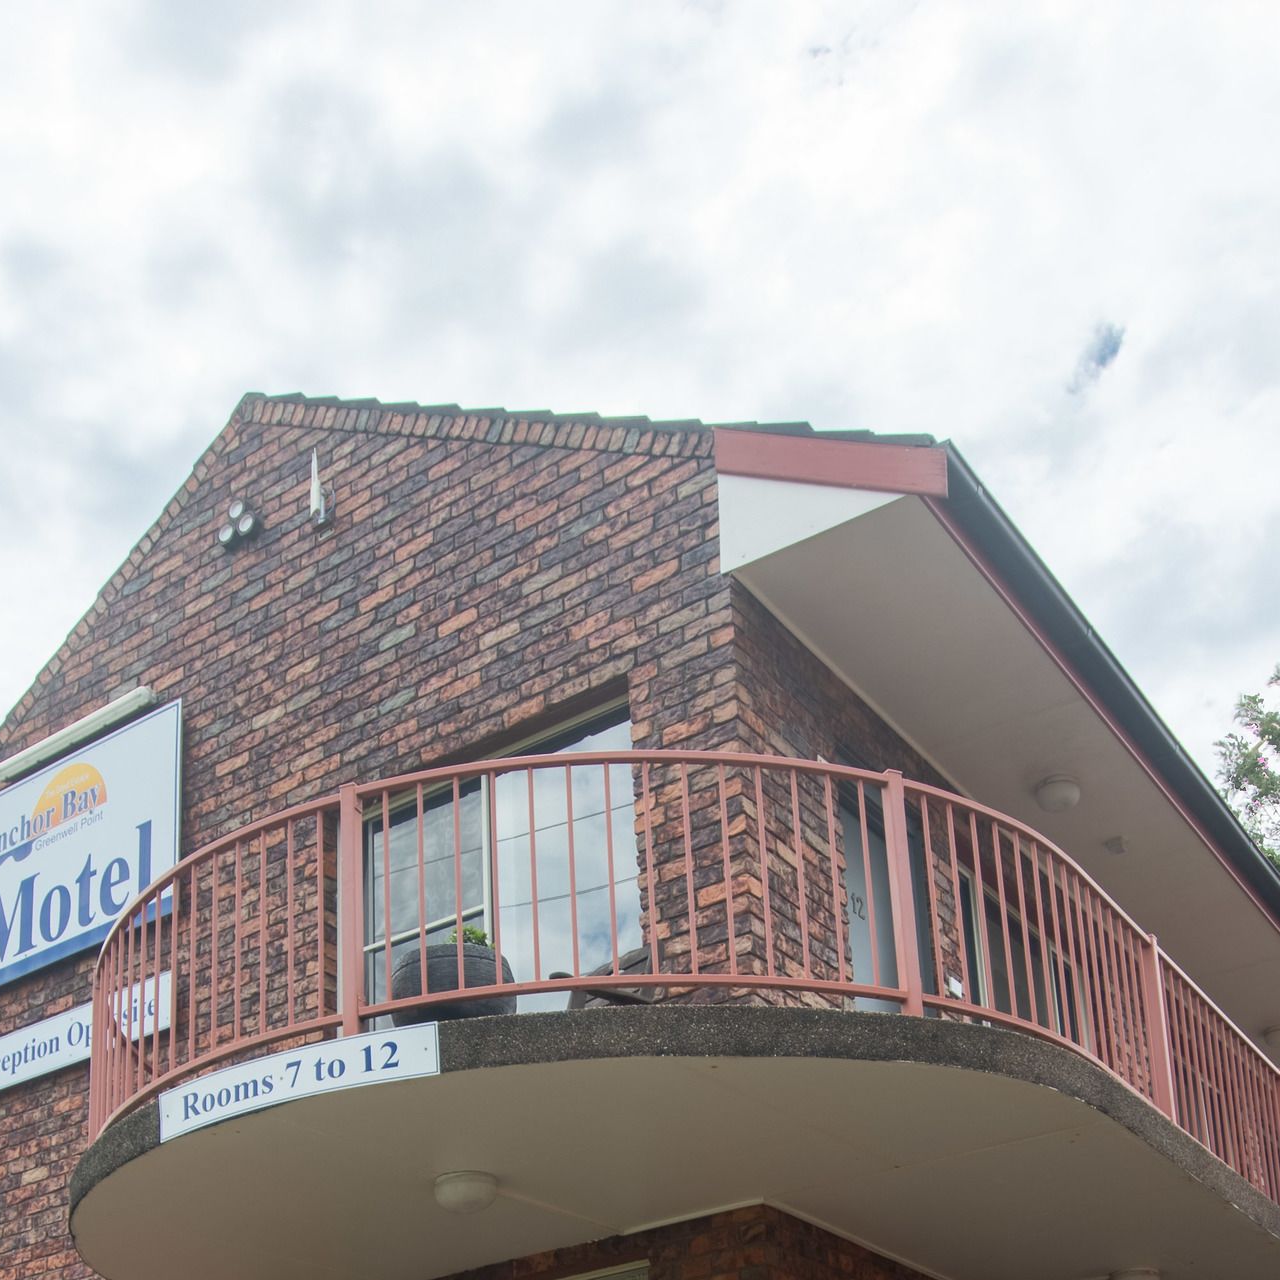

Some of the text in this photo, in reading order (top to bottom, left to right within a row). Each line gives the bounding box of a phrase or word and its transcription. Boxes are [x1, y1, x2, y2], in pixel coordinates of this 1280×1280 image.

[62, 784, 100, 820] Bay
[34, 810, 103, 852] Greenwell Point
[851, 892, 865, 920] 12
[182, 1041, 400, 1121] Rooms 7 to 12
